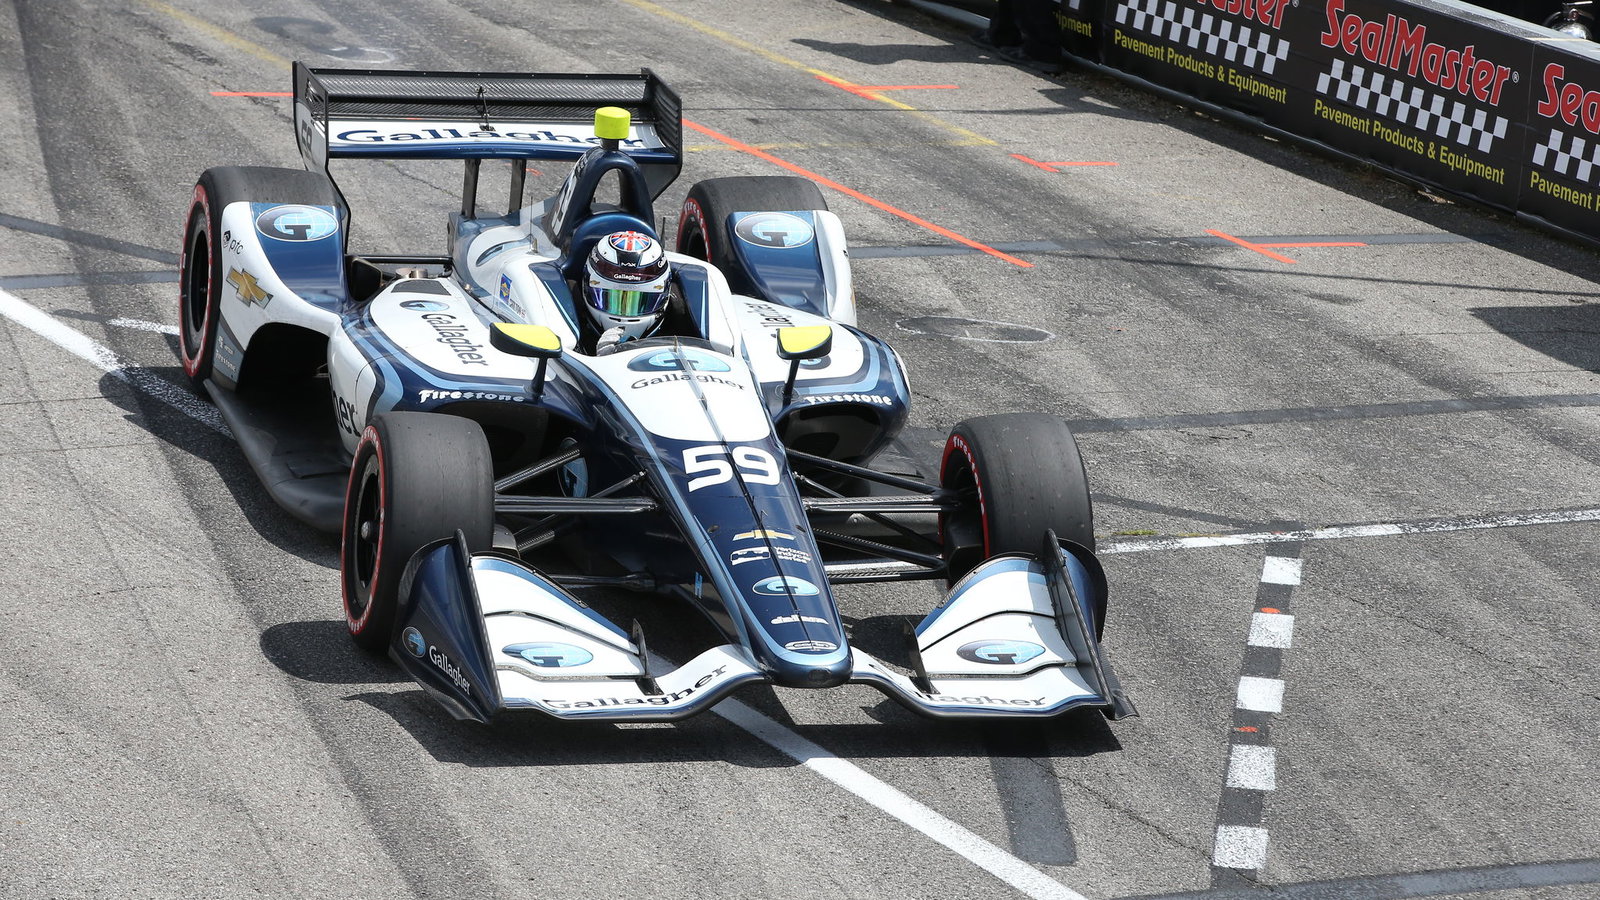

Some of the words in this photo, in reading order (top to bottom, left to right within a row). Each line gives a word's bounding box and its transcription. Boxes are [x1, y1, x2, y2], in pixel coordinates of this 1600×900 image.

[1054, 10, 1092, 38] ipment
[1114, 29, 1164, 62] Pavement
[1167, 46, 1214, 79] Products
[1217, 66, 1226, 81] &
[1228, 71, 1287, 104] Equipment
[1320, 0, 1511, 107] SealMaster
[1314, 98, 1370, 135] Pavement
[1373, 120, 1424, 155] Products
[1427, 142, 1436, 160] &
[1439, 146, 1505, 185] Equipment
[1530, 170, 1593, 210] Pavement
[613, 273, 641, 281] Gallagher
[421, 313, 488, 367] Gallagher
[418, 389, 525, 404] Firestone
[631, 373, 745, 391] Gallagher
[804, 393, 893, 406] Firestone
[682, 445, 781, 493] 59
[429, 645, 471, 696] Gallagher
[541, 664, 728, 709] Gallagher
